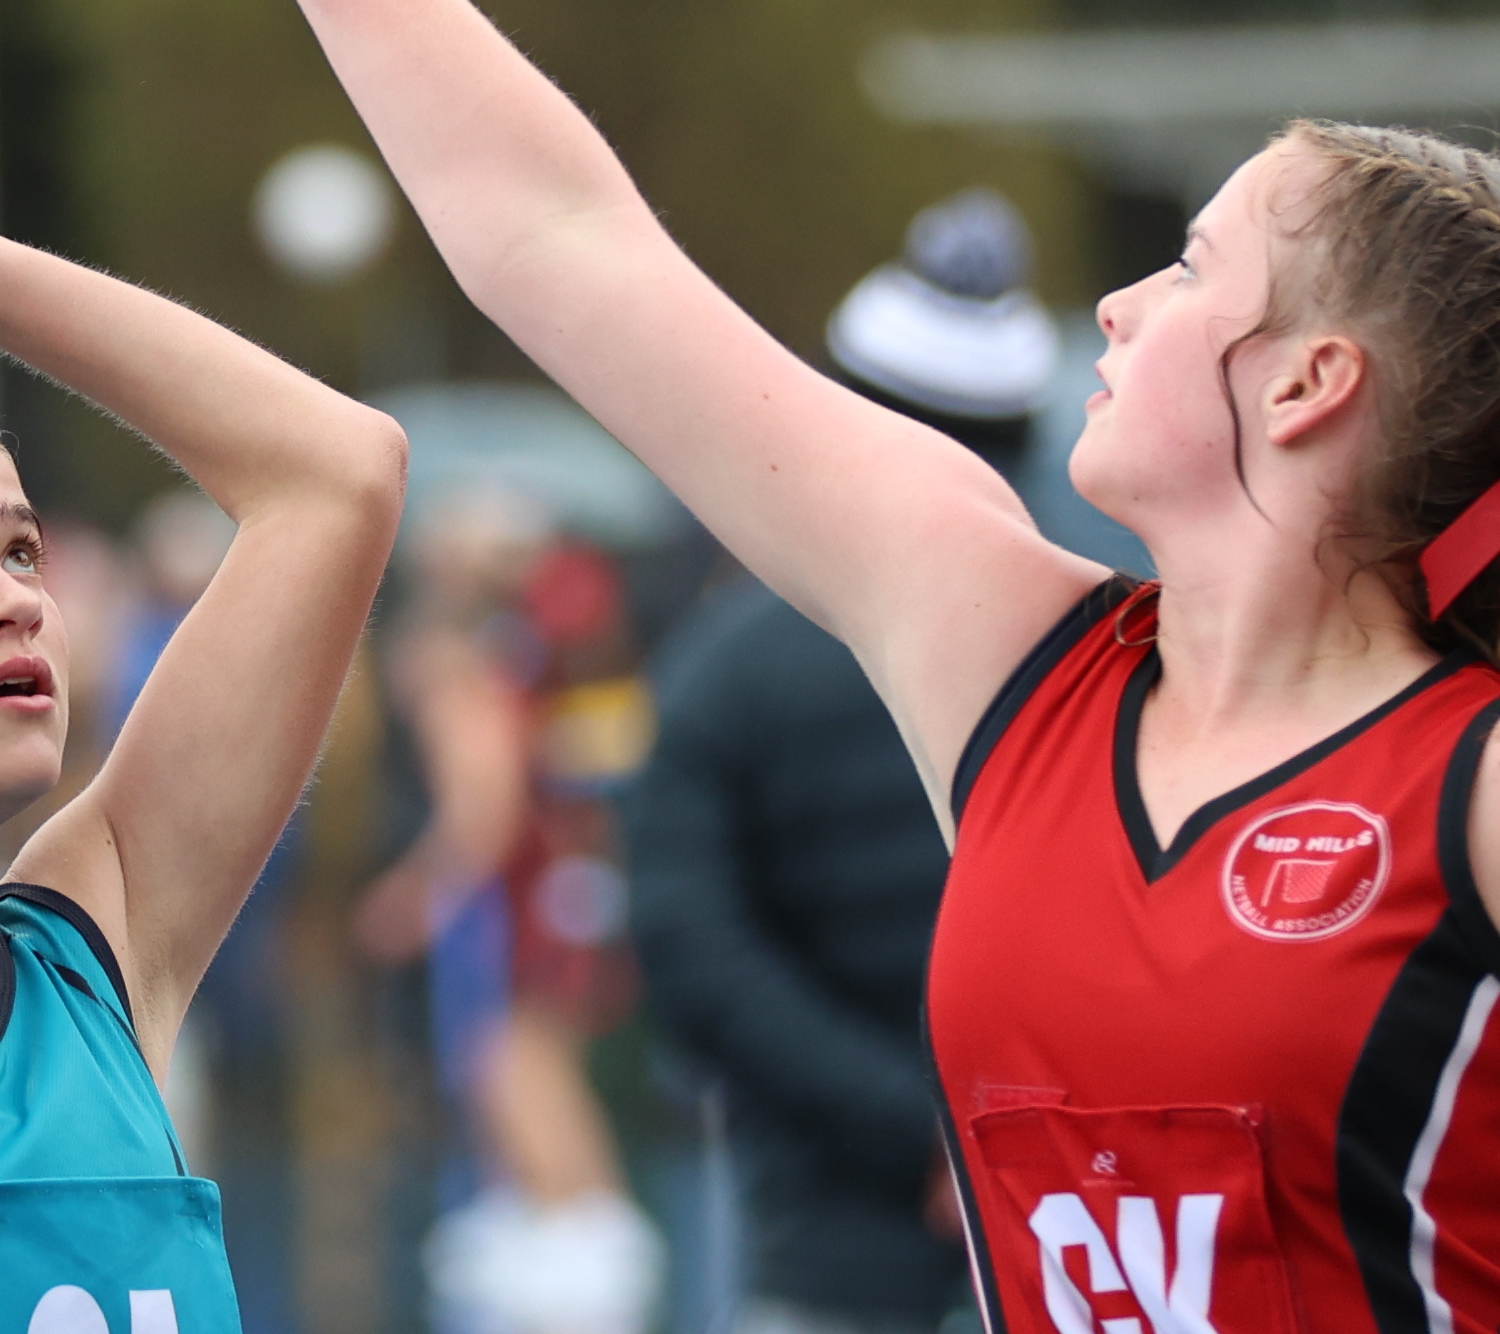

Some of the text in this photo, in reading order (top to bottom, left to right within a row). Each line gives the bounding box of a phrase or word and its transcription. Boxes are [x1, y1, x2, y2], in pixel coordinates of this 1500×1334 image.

[1253, 829, 1374, 853] MID HILLS
[1272, 878, 1373, 931] ASSOCIATION
